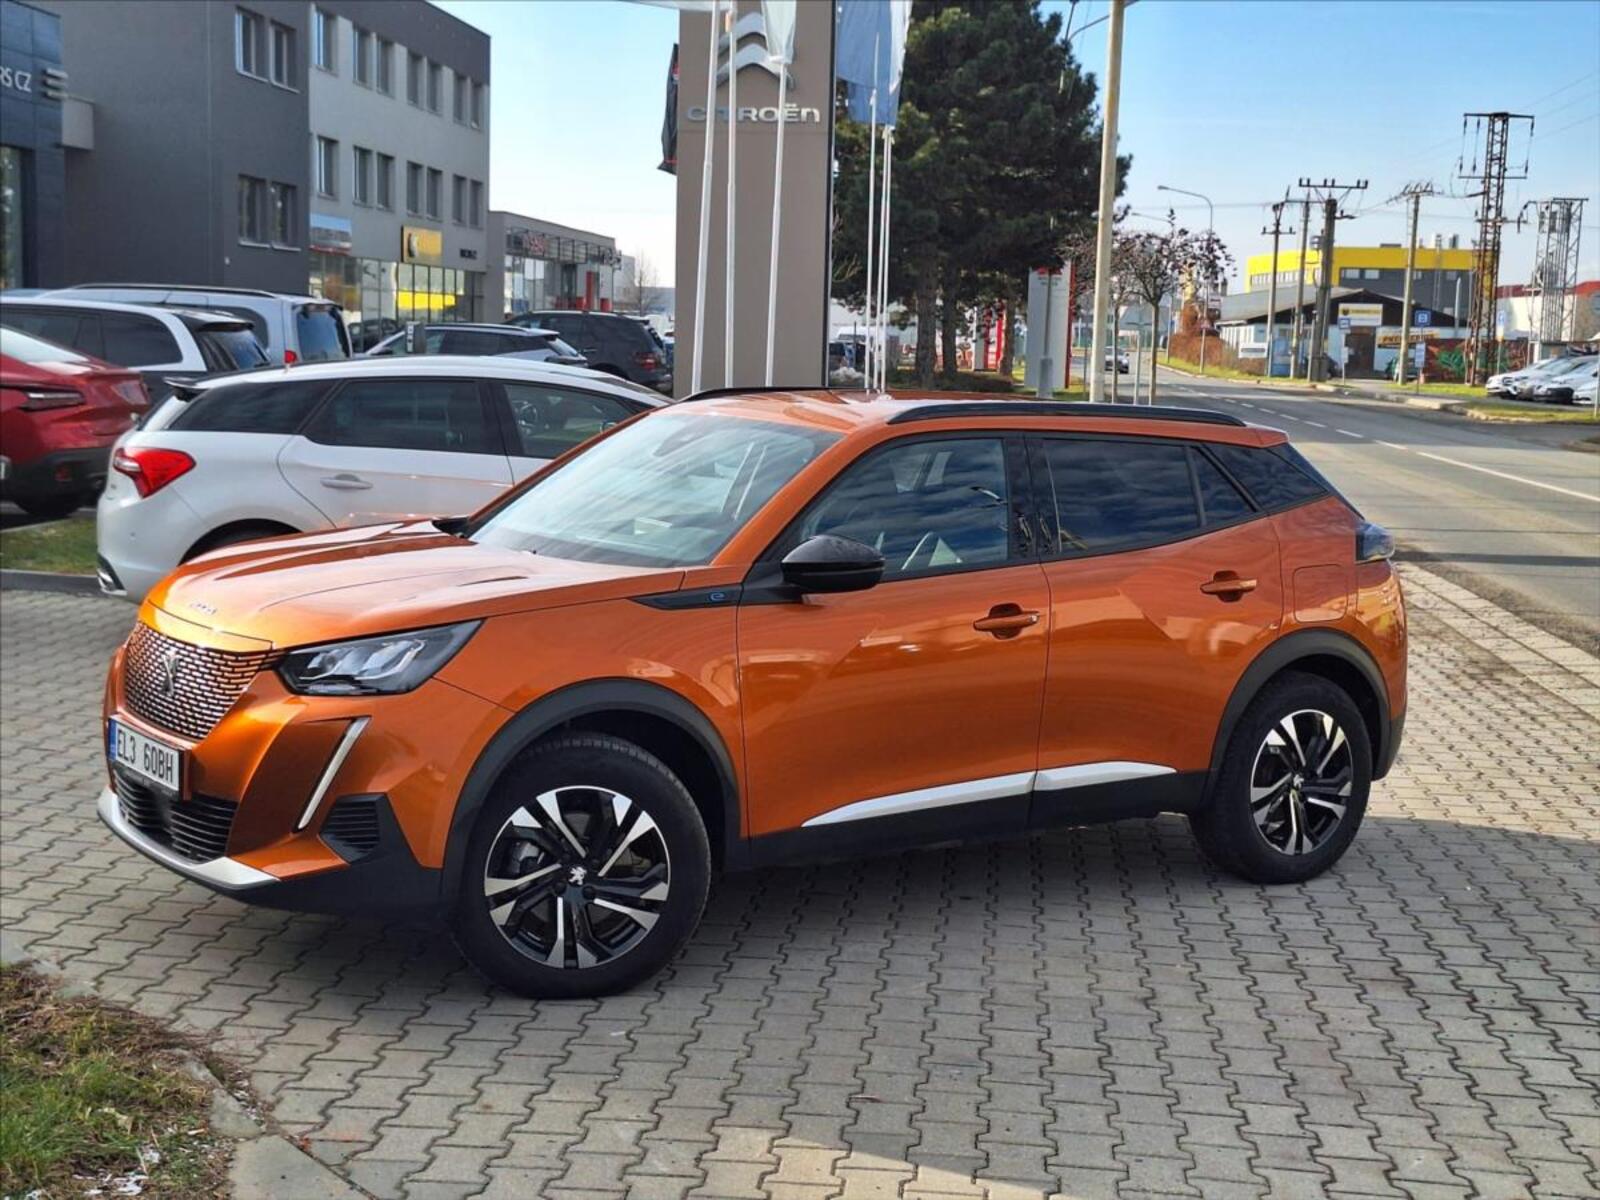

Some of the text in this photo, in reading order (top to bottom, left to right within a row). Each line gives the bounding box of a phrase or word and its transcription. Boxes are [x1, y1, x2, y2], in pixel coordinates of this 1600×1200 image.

[15, 70, 32, 93] CZ
[687, 103, 820, 122] CTROËN
[117, 728, 136, 765] EL3
[144, 742, 174, 784] 60BH
